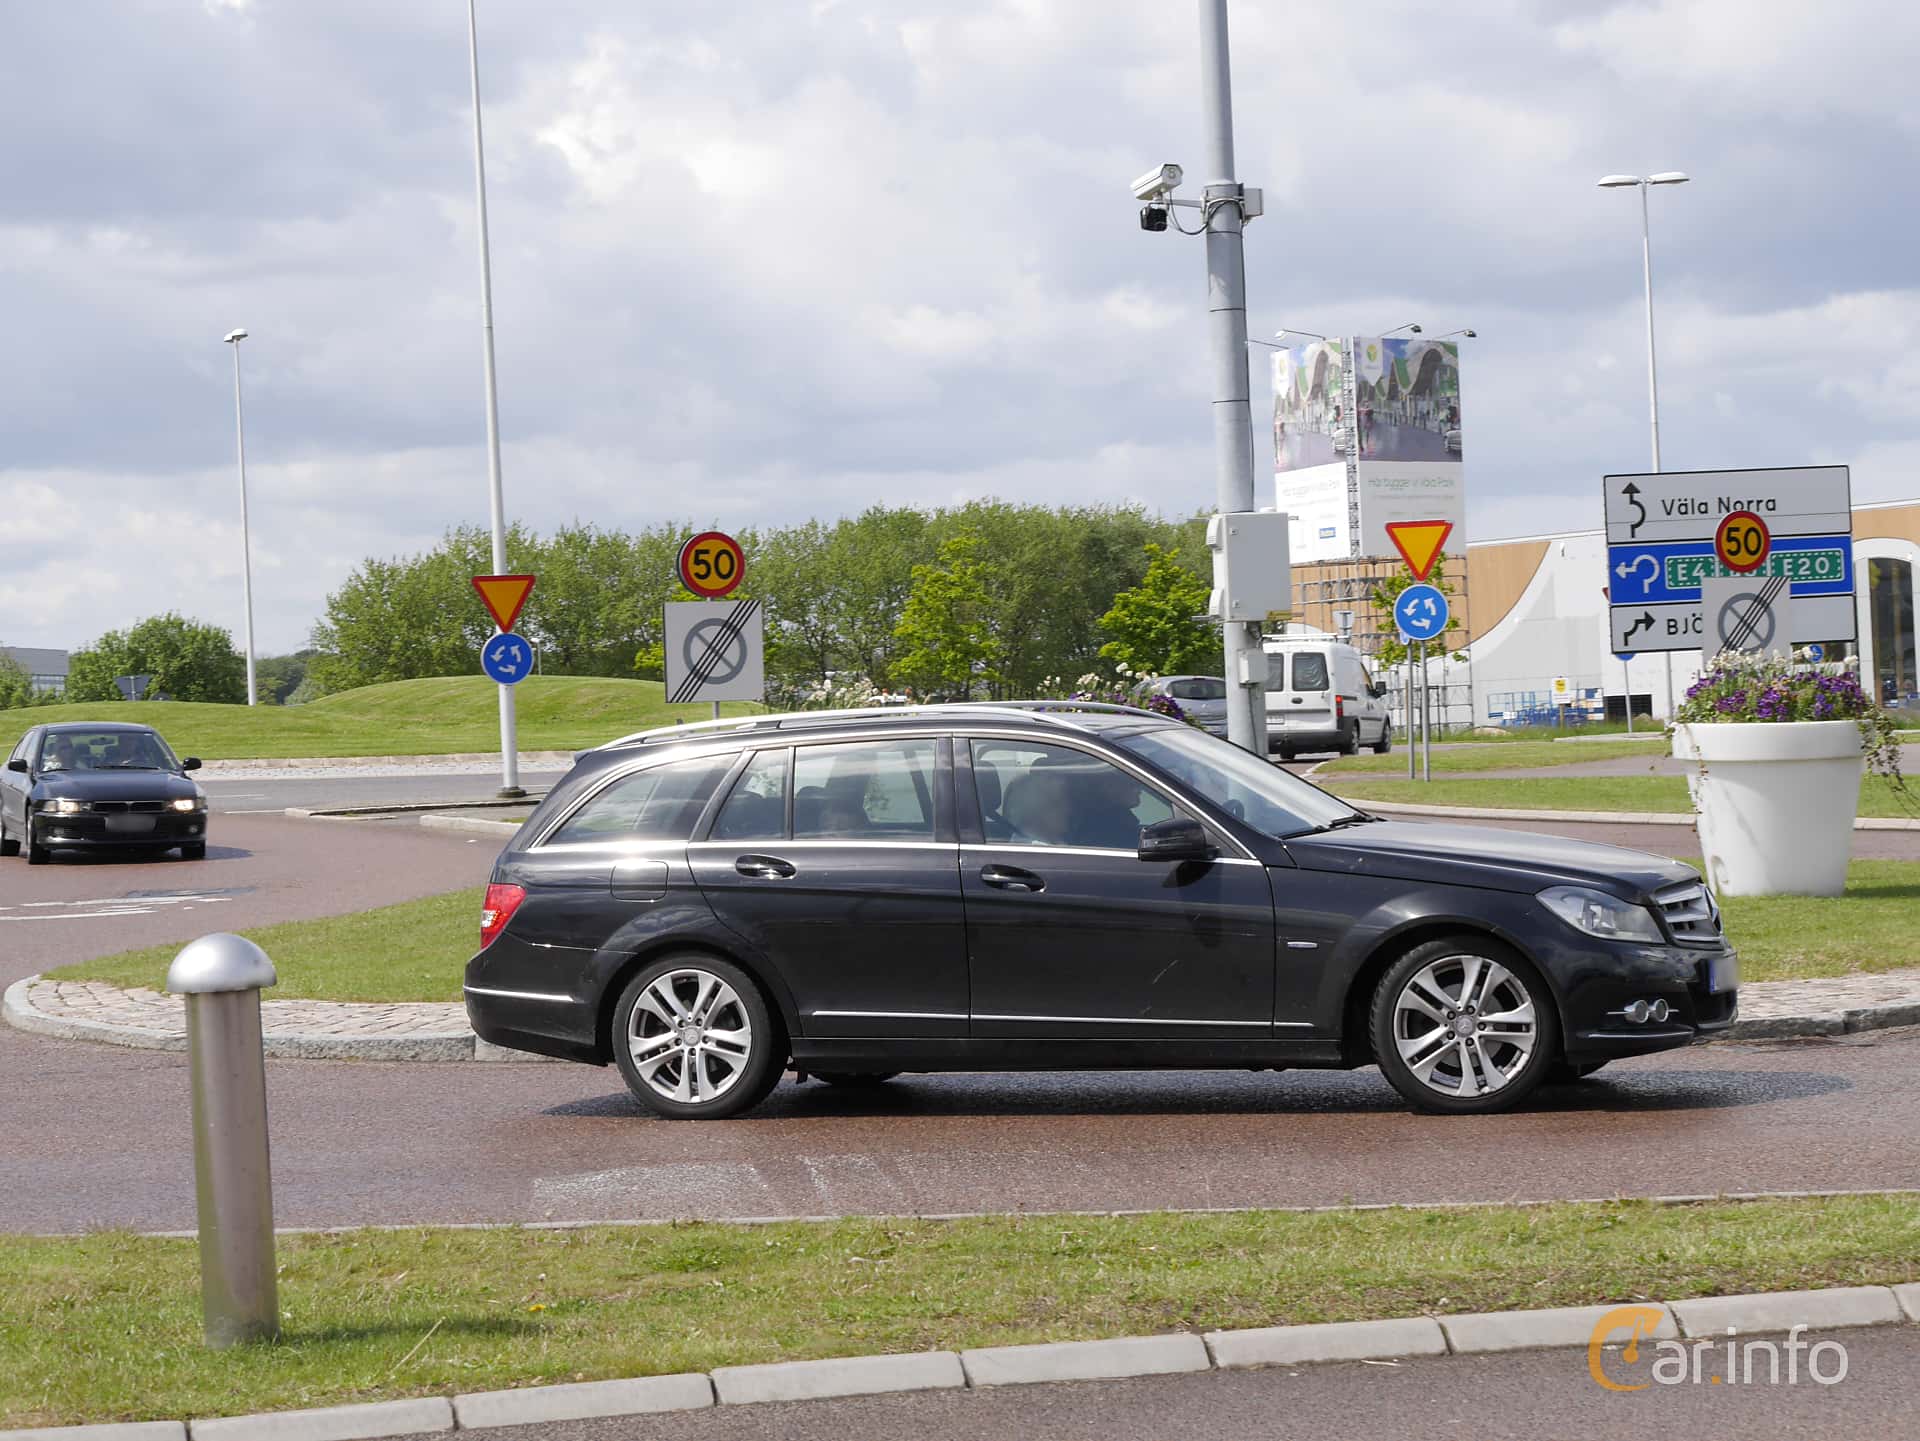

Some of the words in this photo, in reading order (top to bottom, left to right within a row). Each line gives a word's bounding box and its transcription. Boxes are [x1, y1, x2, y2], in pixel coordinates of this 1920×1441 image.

[1662, 498, 1709, 516] Väla
[1717, 497, 1776, 512] Norra
[1725, 526, 1762, 557] 50
[693, 549, 735, 580] 50
[1677, 563, 1706, 580] E4
[1783, 557, 1830, 575] E20
